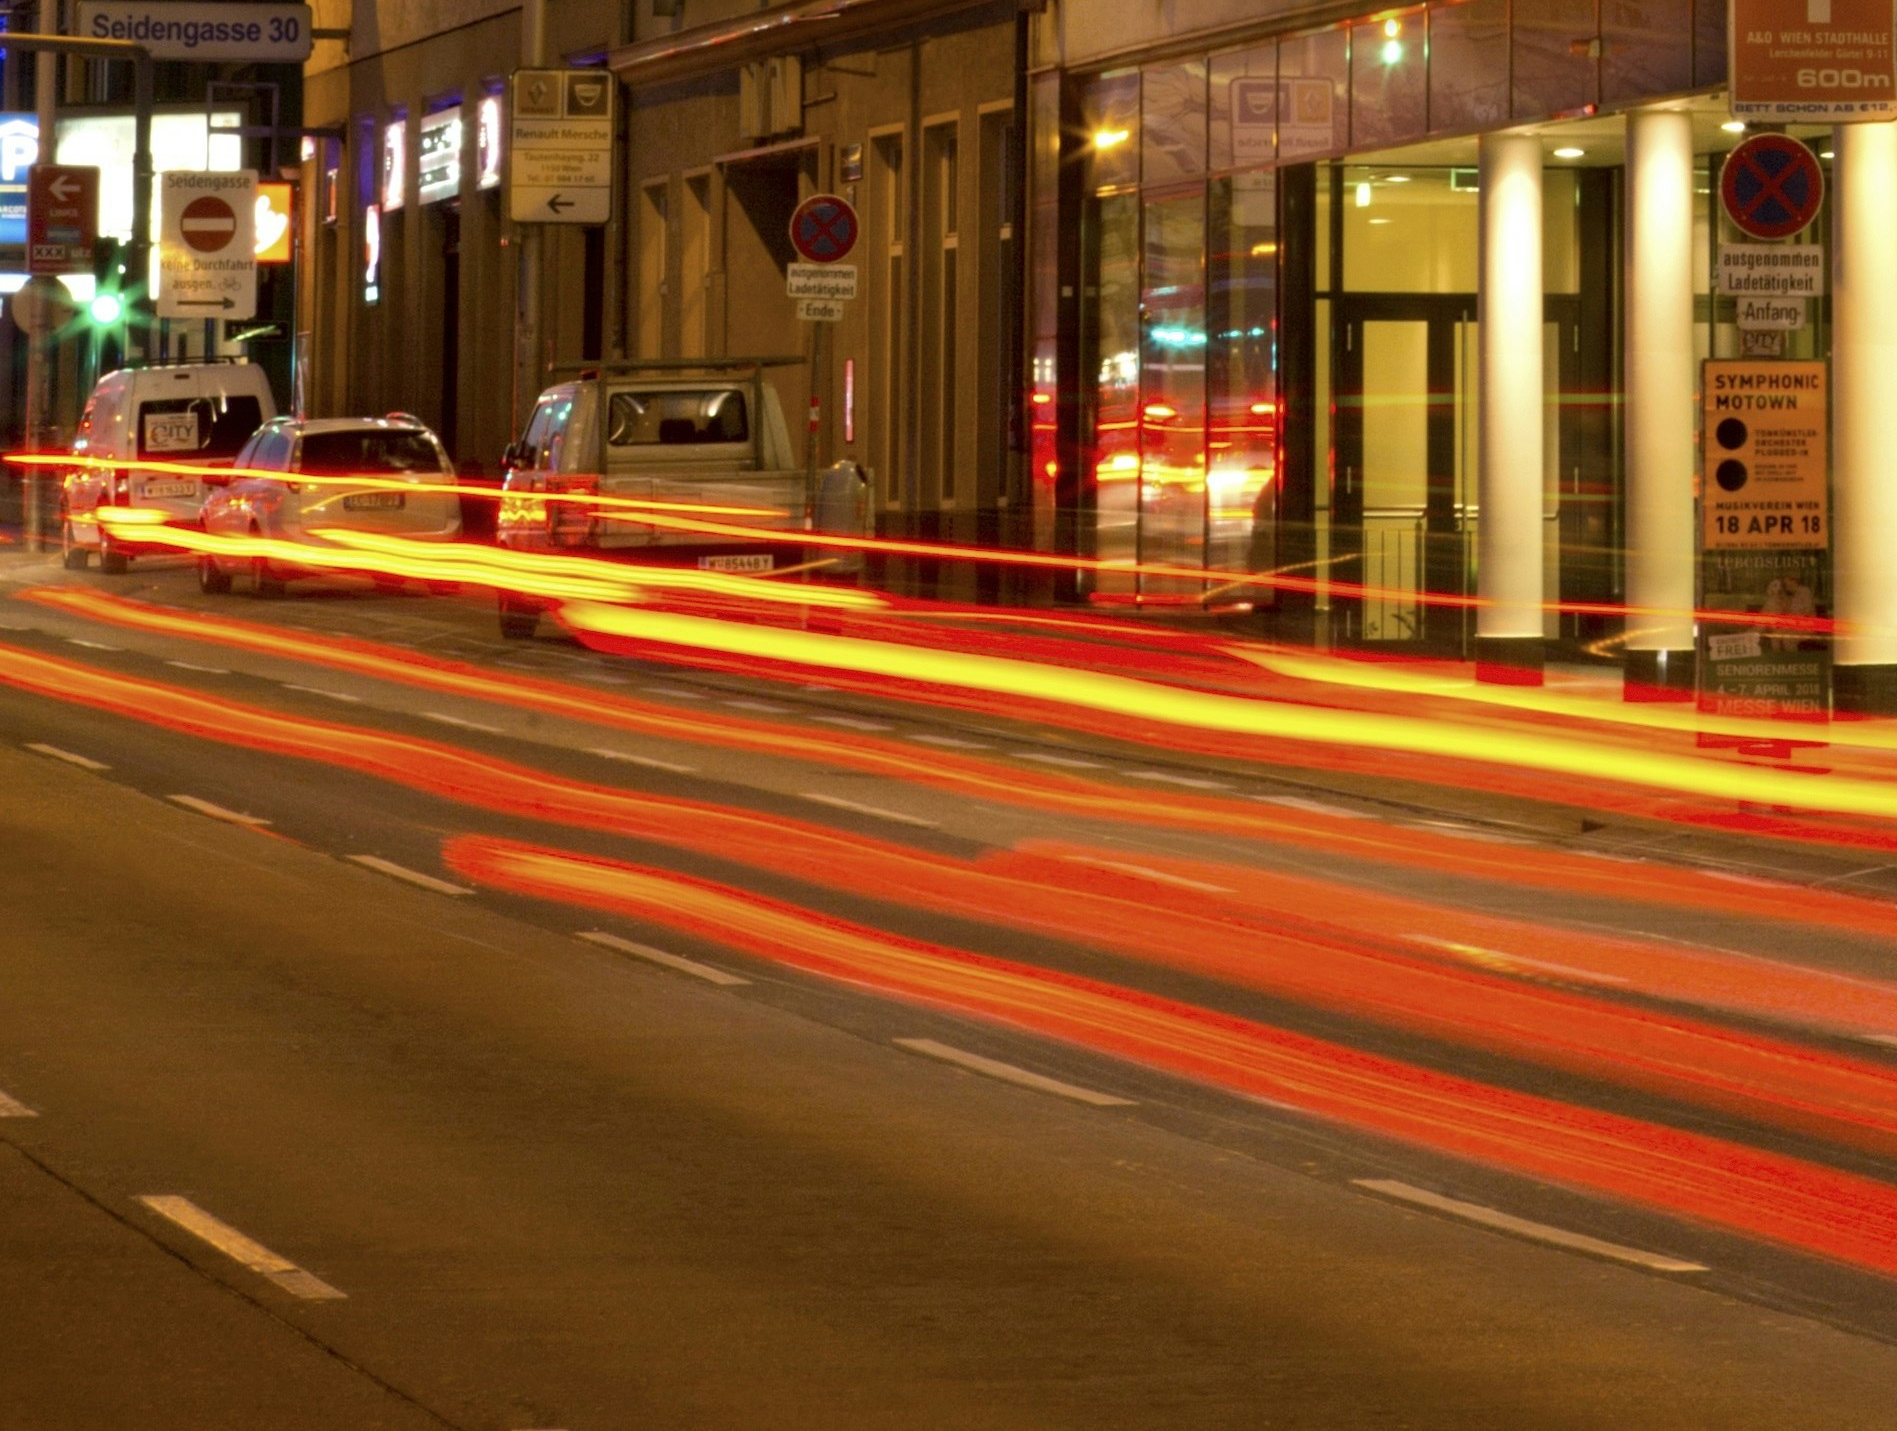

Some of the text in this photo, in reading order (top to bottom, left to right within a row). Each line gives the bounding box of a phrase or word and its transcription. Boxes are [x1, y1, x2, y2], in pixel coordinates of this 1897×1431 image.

[92, 14, 299, 48] Seidengasse 30
[1780, 31, 1811, 44] WIEN
[1816, 31, 1888, 45] STADTHALLE
[1797, 69, 1891, 88] 600m
[1735, 103, 1770, 114] BETT
[1834, 103, 1855, 114] AB
[516, 128, 609, 141] Renault Mersche
[168, 175, 250, 191] Seidengasse
[194, 258, 253, 272] Durchfahrt
[1724, 253, 1819, 270] ausgenommen
[1728, 273, 1813, 294] Ladetätigkeit
[1715, 374, 1819, 390] SYMPHONIC
[1716, 395, 1798, 410] MOTOWN
[1716, 501, 1820, 511] MUSIKVEREIN WIEN
[1716, 516, 1821, 534] 18 APR 18
[1717, 663, 1819, 677] SENIORENMESSE
[1754, 684, 1791, 695] APRIL
[1781, 699, 1820, 714] WIEN
